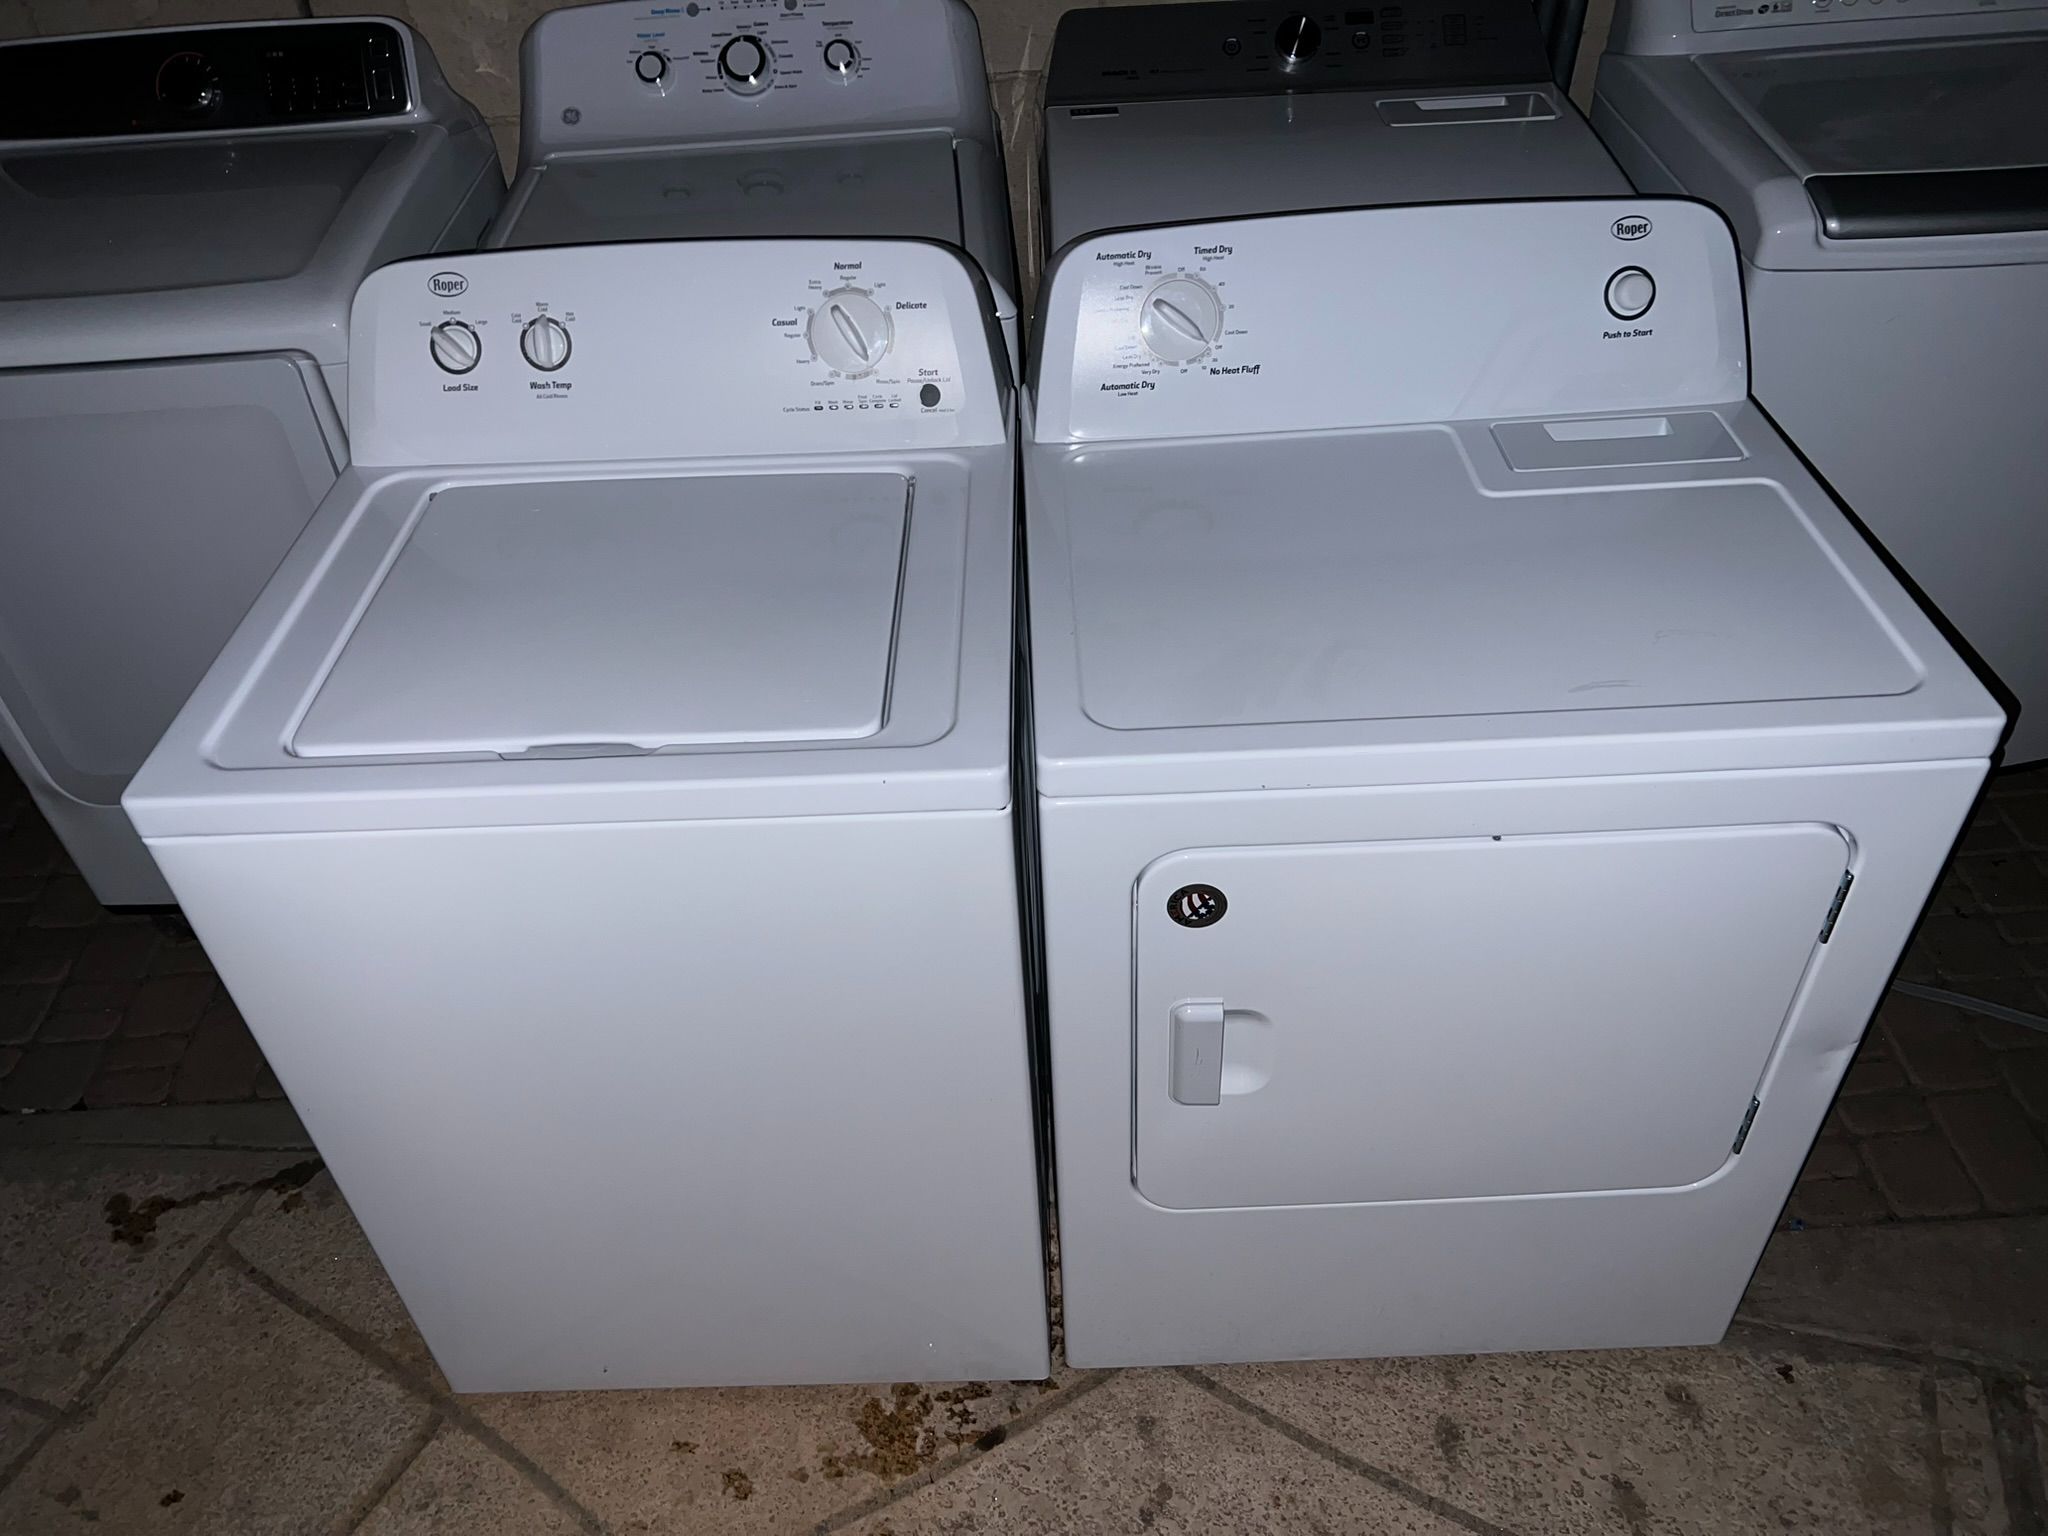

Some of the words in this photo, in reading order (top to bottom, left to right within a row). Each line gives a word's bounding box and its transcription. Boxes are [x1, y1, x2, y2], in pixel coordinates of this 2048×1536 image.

[1616, 223, 1649, 236] Roper
[1194, 246, 1218, 255] Timed
[1219, 245, 1233, 255] Dry
[1096, 251, 1137, 261] Automatic
[1138, 251, 1152, 260] Dry
[834, 261, 862, 270] Normal
[433, 278, 465, 293] Roper
[895, 302, 927, 310] Delicate
[771, 318, 798, 327] Casual
[1603, 331, 1622, 339] Push
[1632, 329, 1653, 337] Start
[918, 368, 938, 377] Start
[1210, 367, 1221, 375] No
[1222, 366, 1240, 374] Heat
[1241, 364, 1261, 374] Fluff
[552, 381, 572, 390] Temp
[1100, 381, 1140, 391] Automatic
[1141, 381, 1155, 391] Dry
